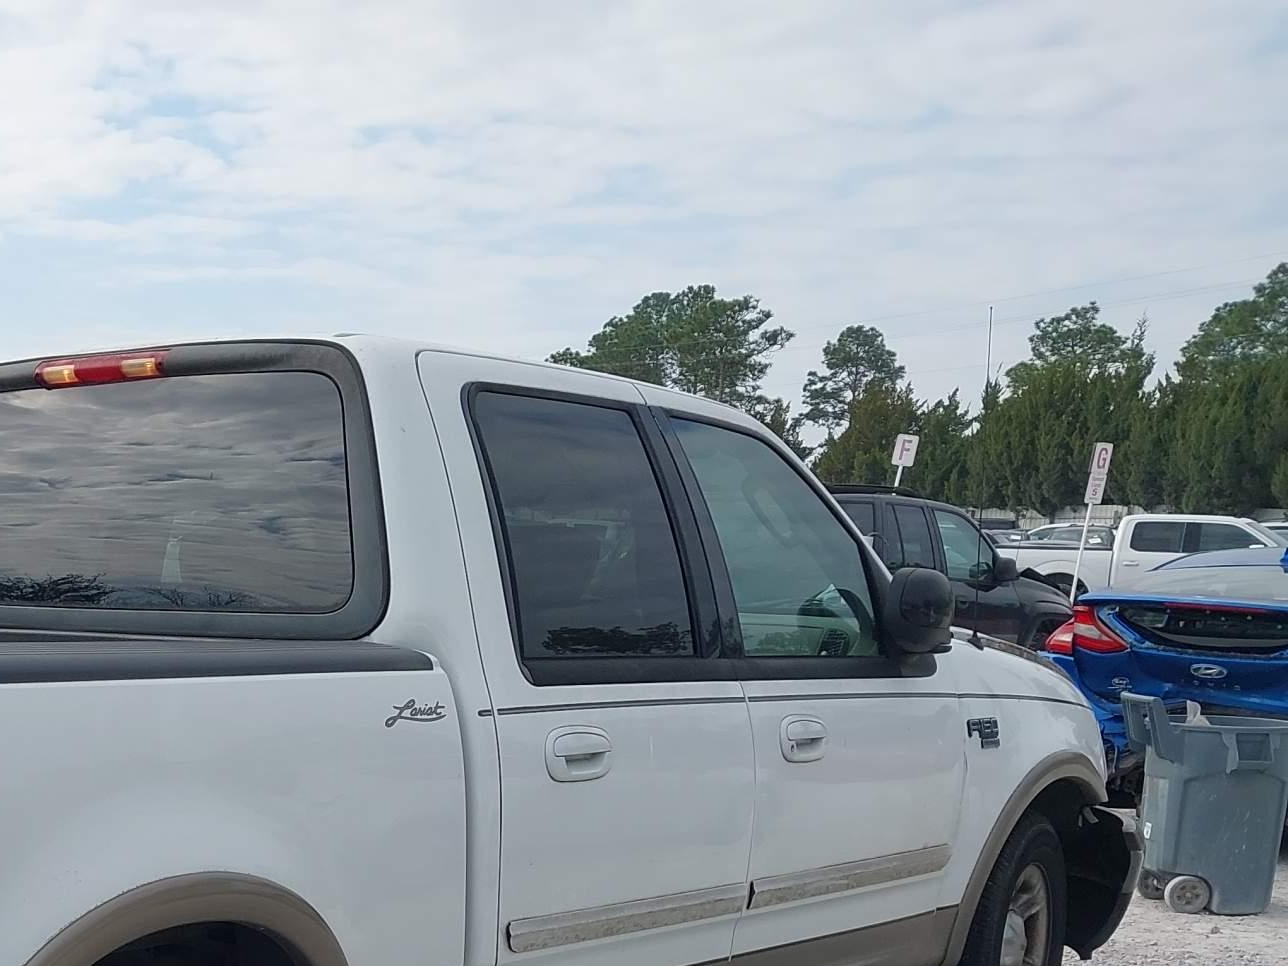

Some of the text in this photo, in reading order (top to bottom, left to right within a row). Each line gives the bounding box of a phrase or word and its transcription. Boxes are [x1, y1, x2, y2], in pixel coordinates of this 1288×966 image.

[899, 439, 913, 461] F
[1096, 447, 1108, 469] G
[385, 699, 447, 728] Lariat
